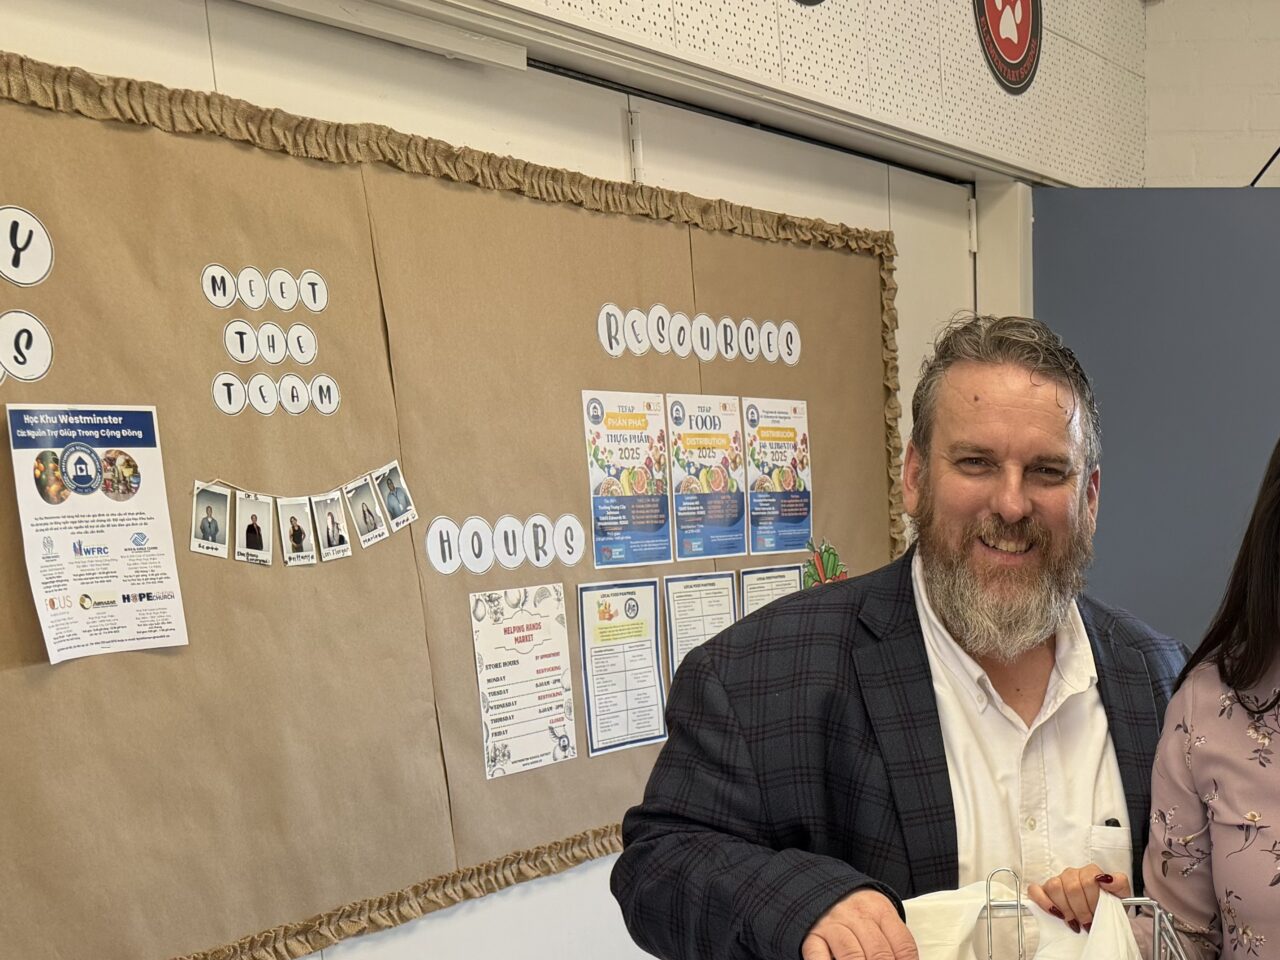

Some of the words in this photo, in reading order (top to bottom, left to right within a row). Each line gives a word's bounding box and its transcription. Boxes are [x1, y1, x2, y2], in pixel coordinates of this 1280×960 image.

[210, 274, 319, 304] MEET
[606, 311, 794, 357] RESOURCES
[235, 330, 305, 355] THE
[221, 382, 332, 405] TEAM
[40, 414, 58, 424] Khu
[58, 414, 124, 425] Westminster
[688, 414, 722, 430] FOOD
[78, 429, 100, 439] Trong
[618, 447, 641, 461] 2025
[697, 446, 717, 459] 2025
[770, 450, 788, 462] 2025
[83, 546, 109, 556] WFRC
[440, 528, 575, 564] HOURS
[122, 592, 153, 604] HOPE
[504, 625, 526, 636] HELPING
[526, 621, 542, 633] HANDS
[514, 633, 534, 645] MARKET
[485, 661, 502, 671] STORE
[502, 659, 520, 668] HOURS
[486, 675, 506, 684] MONDAY
[488, 688, 509, 698] TUESDAY
[489, 701, 518, 711] WEDNESDAY
[490, 714, 515, 725] THURSDAY
[491, 729, 509, 738] FRIDAY
